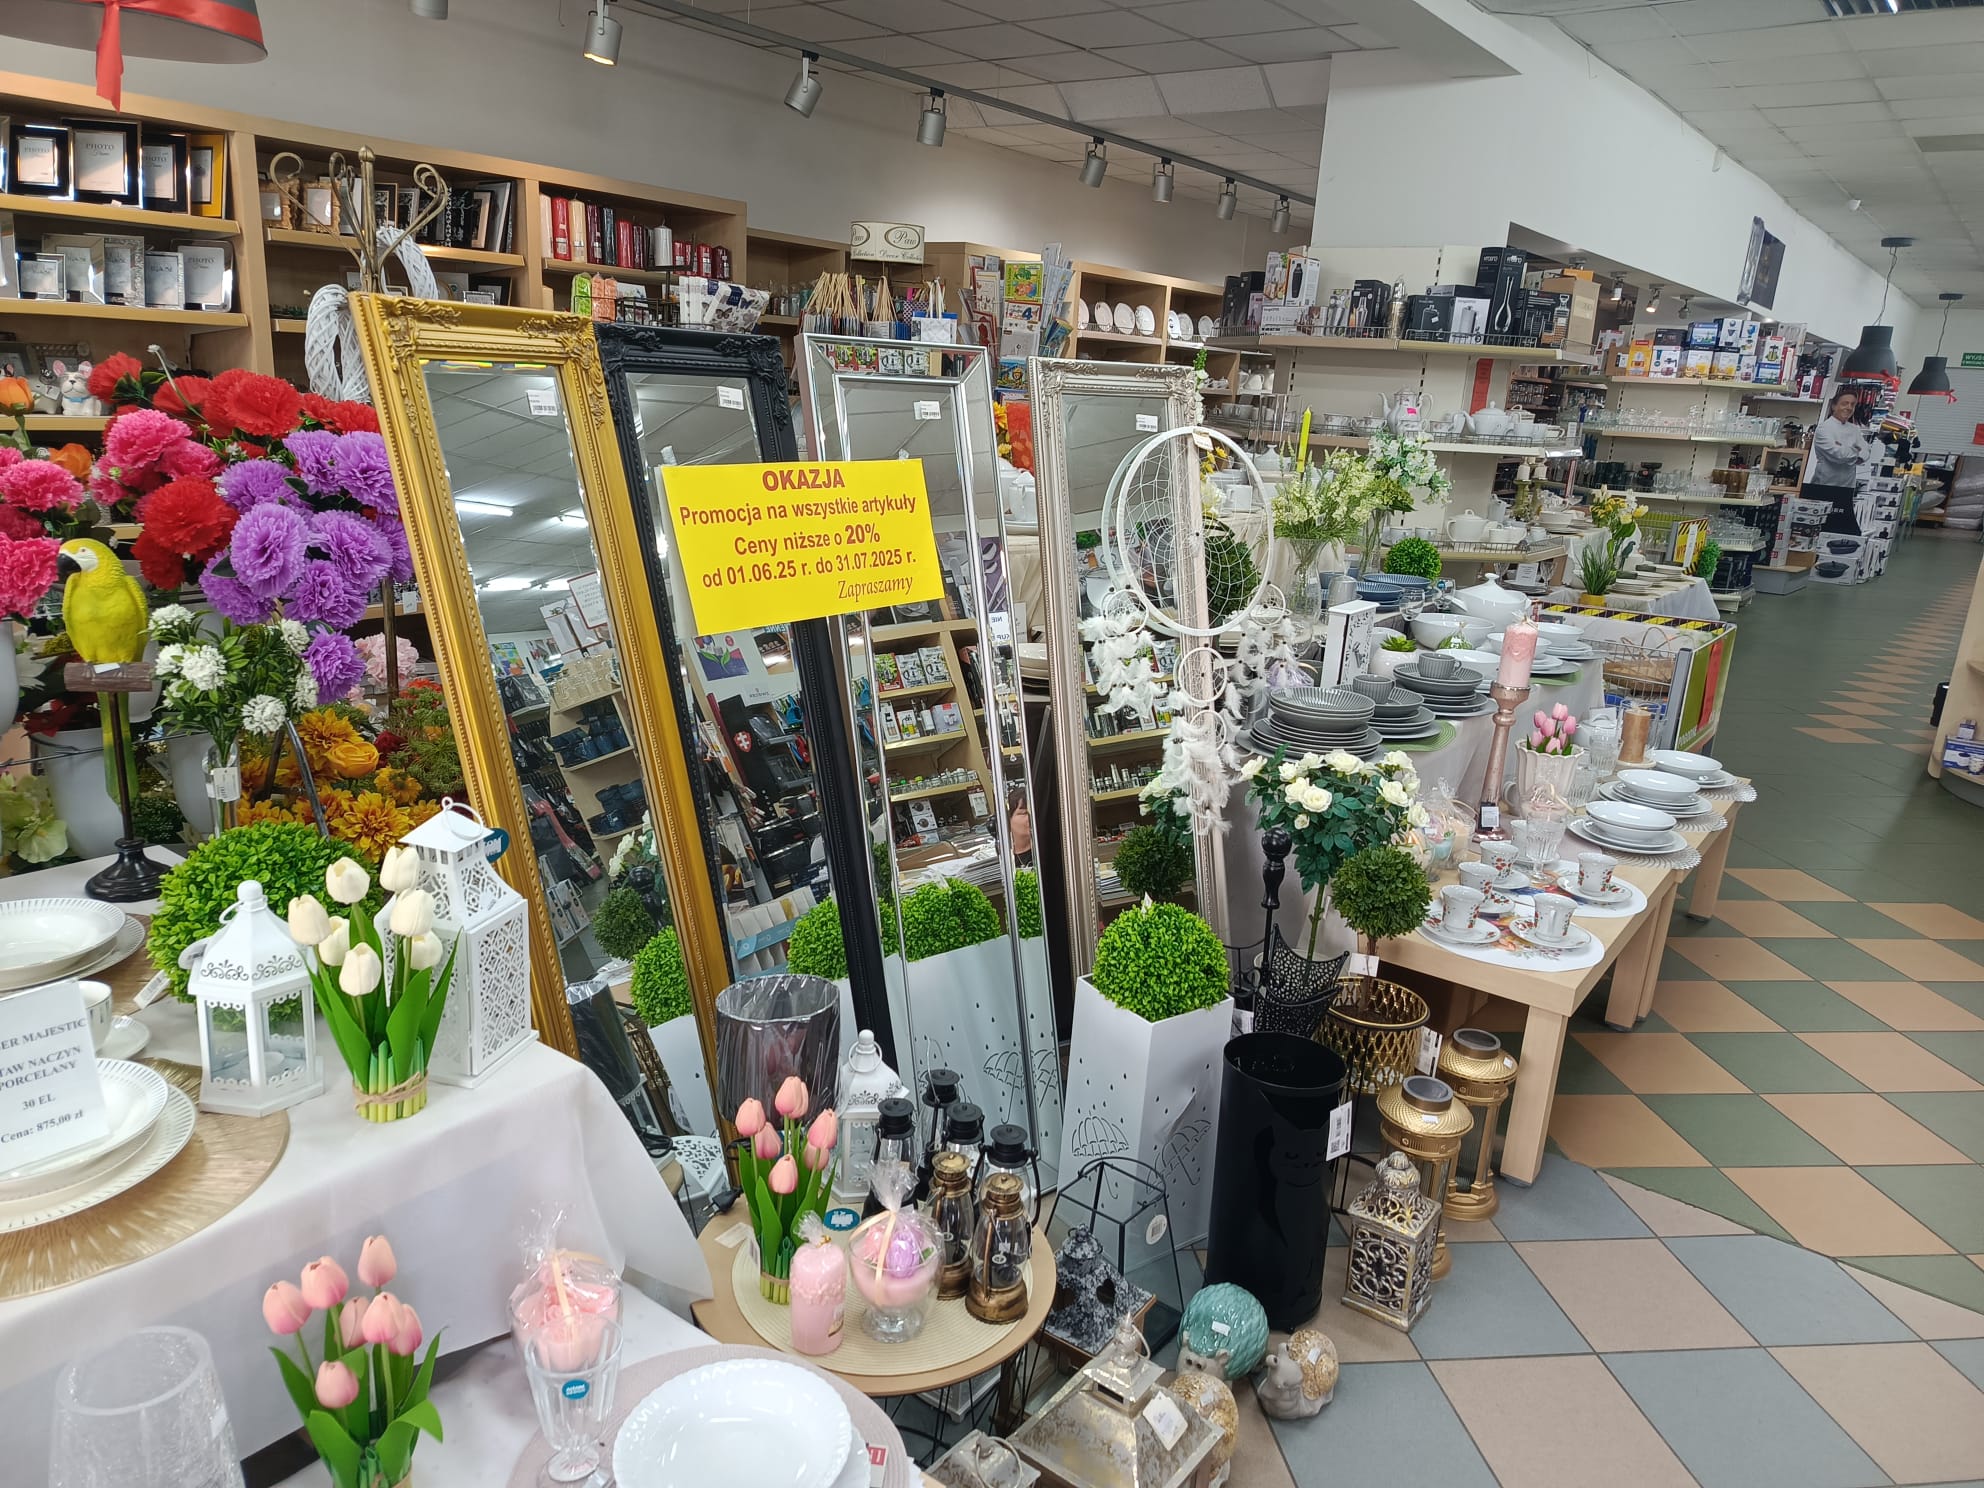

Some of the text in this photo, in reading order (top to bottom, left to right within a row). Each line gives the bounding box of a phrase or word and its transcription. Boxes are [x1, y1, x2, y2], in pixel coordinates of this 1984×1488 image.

[86, 142, 115, 151] PHOTO
[762, 468, 846, 492] OKAZJA
[679, 494, 917, 526] Promocja na wszystkie artykuły
[734, 523, 881, 557] Ceny niższe o 20%
[702, 548, 917, 588] od 01.06.25 r. do 31.07.2025 r.
[837, 576, 914, 602] Zapraszamy
[22, 1018, 87, 1044] MAJESTIC
[29, 1046, 81, 1068] NACZYN
[0, 1061, 77, 1091] PORCELANY
[22, 1093, 56, 1110] 30 EL
[1, 1109, 83, 1143] Cena: 875,00 zł
